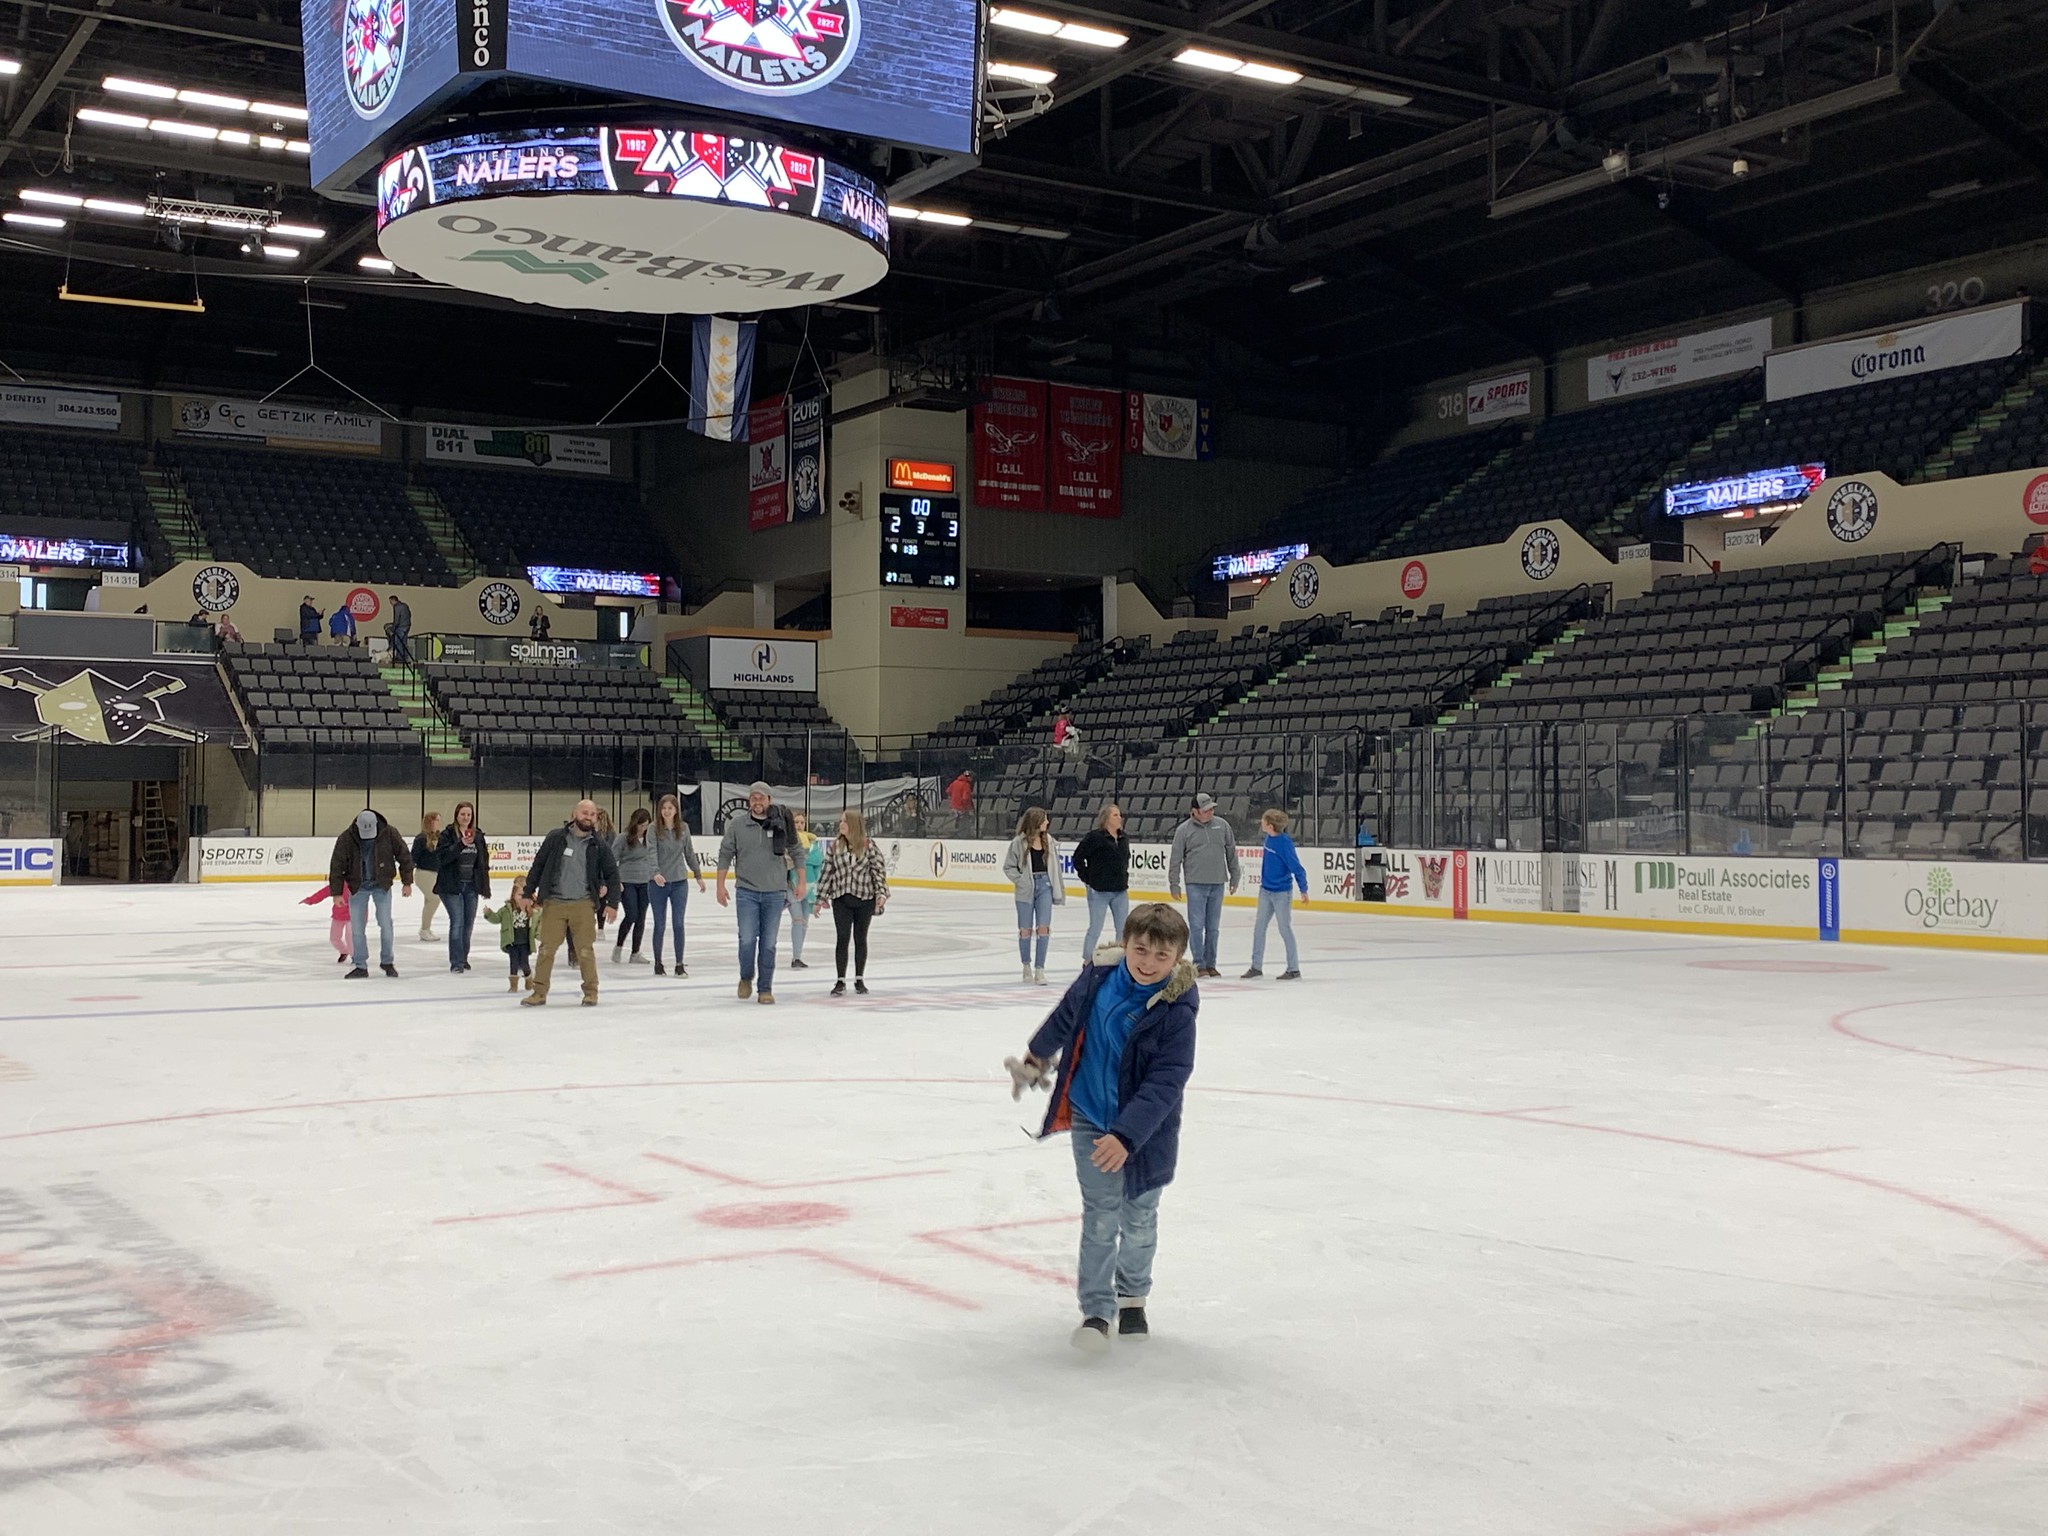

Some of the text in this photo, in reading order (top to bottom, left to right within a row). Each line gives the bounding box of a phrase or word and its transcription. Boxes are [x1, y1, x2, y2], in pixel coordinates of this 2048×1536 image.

[816, 17, 835, 29] 2022
[682, 19, 828, 83] NAILERS
[465, 147, 565, 162] WHEELING
[626, 139, 647, 152] 1992
[456, 154, 580, 187] NAILERS
[790, 161, 807, 175] 2022
[437, 214, 846, 292] WesBanco
[1926, 276, 1985, 314] 320
[1851, 345, 1925, 379] Corona
[5, 393, 47, 404] DENTIST
[1487, 380, 1529, 400] SPORTS
[57, 403, 118, 416] 304.243.1500
[793, 399, 820, 423] 2016
[1437, 391, 1464, 419] 318
[257, 408, 373, 428] GETZIK FAMILY
[432, 427, 469, 440] DIAL
[436, 439, 464, 453] 811
[524, 434, 550, 455] 811
[912, 471, 951, 483] McDonald's
[1706, 477, 1785, 505] NAILERS
[1828, 483, 1876, 511] WHEELING
[890, 516, 901, 533] 2
[917, 521, 926, 535] 3
[948, 520, 958, 538] 3
[1832, 520, 1873, 541] NAILERS
[1522, 529, 1558, 552] WHEELING
[0, 543, 86, 561] NAILERS
[1228, 557, 1277, 576] NAILERS
[1525, 563, 1556, 579] NAILERS
[194, 567, 237, 588] WHEELING
[576, 575, 643, 592] NAILERS
[480, 583, 519, 603] WHEELING
[197, 595, 235, 612] NAILERS
[483, 610, 516, 625] NAILERS
[510, 641, 578, 661] spilman
[733, 673, 795, 684] HIGHLANDS
[201, 847, 265, 861] SPORTS
[951, 852, 997, 864] HIGHLANDS
[1131, 850, 1167, 870] icket
[1323, 874, 1343, 883] WITH
[1678, 867, 1811, 889] Paull Associates
[1678, 889, 1733, 902] Real Estate
[1678, 904, 1693, 914] Lee
[1703, 905, 1726, 917] Paull,
[1726, 906, 1737, 917] IV,
[1738, 906, 1766, 917] Broker
[1904, 887, 1998, 928] Oglebay
